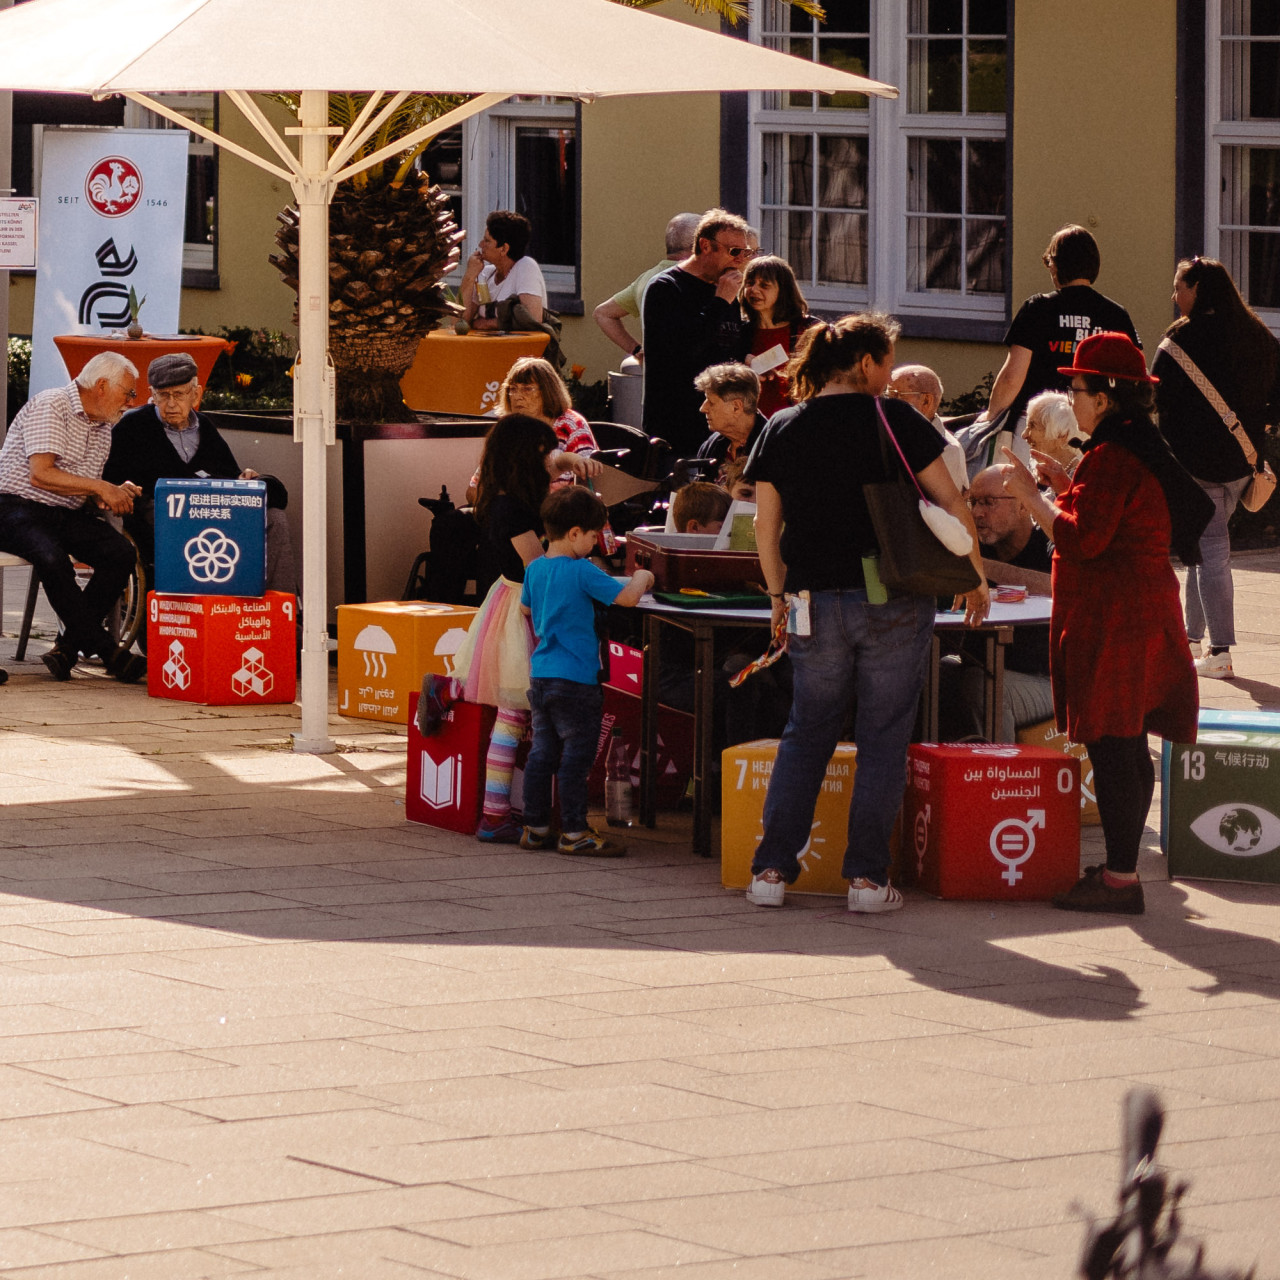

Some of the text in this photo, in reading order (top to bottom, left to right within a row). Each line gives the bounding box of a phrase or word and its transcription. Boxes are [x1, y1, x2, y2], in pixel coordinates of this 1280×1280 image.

[57, 196, 168, 207] SEIT 1546
[1059, 315, 1091, 328] HIER
[166, 493, 263, 518] 17 促进目标实现的
[188, 508, 232, 520] 伙伴关系
[150, 599, 159, 622] 9
[210, 603, 241, 616] والابتكار
[243, 602, 271, 612] الصناعة
[238, 616, 271, 629] والهياكل
[235, 630, 271, 641] الأساسية
[1180, 750, 1270, 780] 13 气候行动
[735, 759, 748, 790] 7
[963, 767, 982, 782] بين
[987, 766, 1040, 782] المساواة
[752, 778, 760, 790] И
[991, 786, 1040, 801] الجنسين
